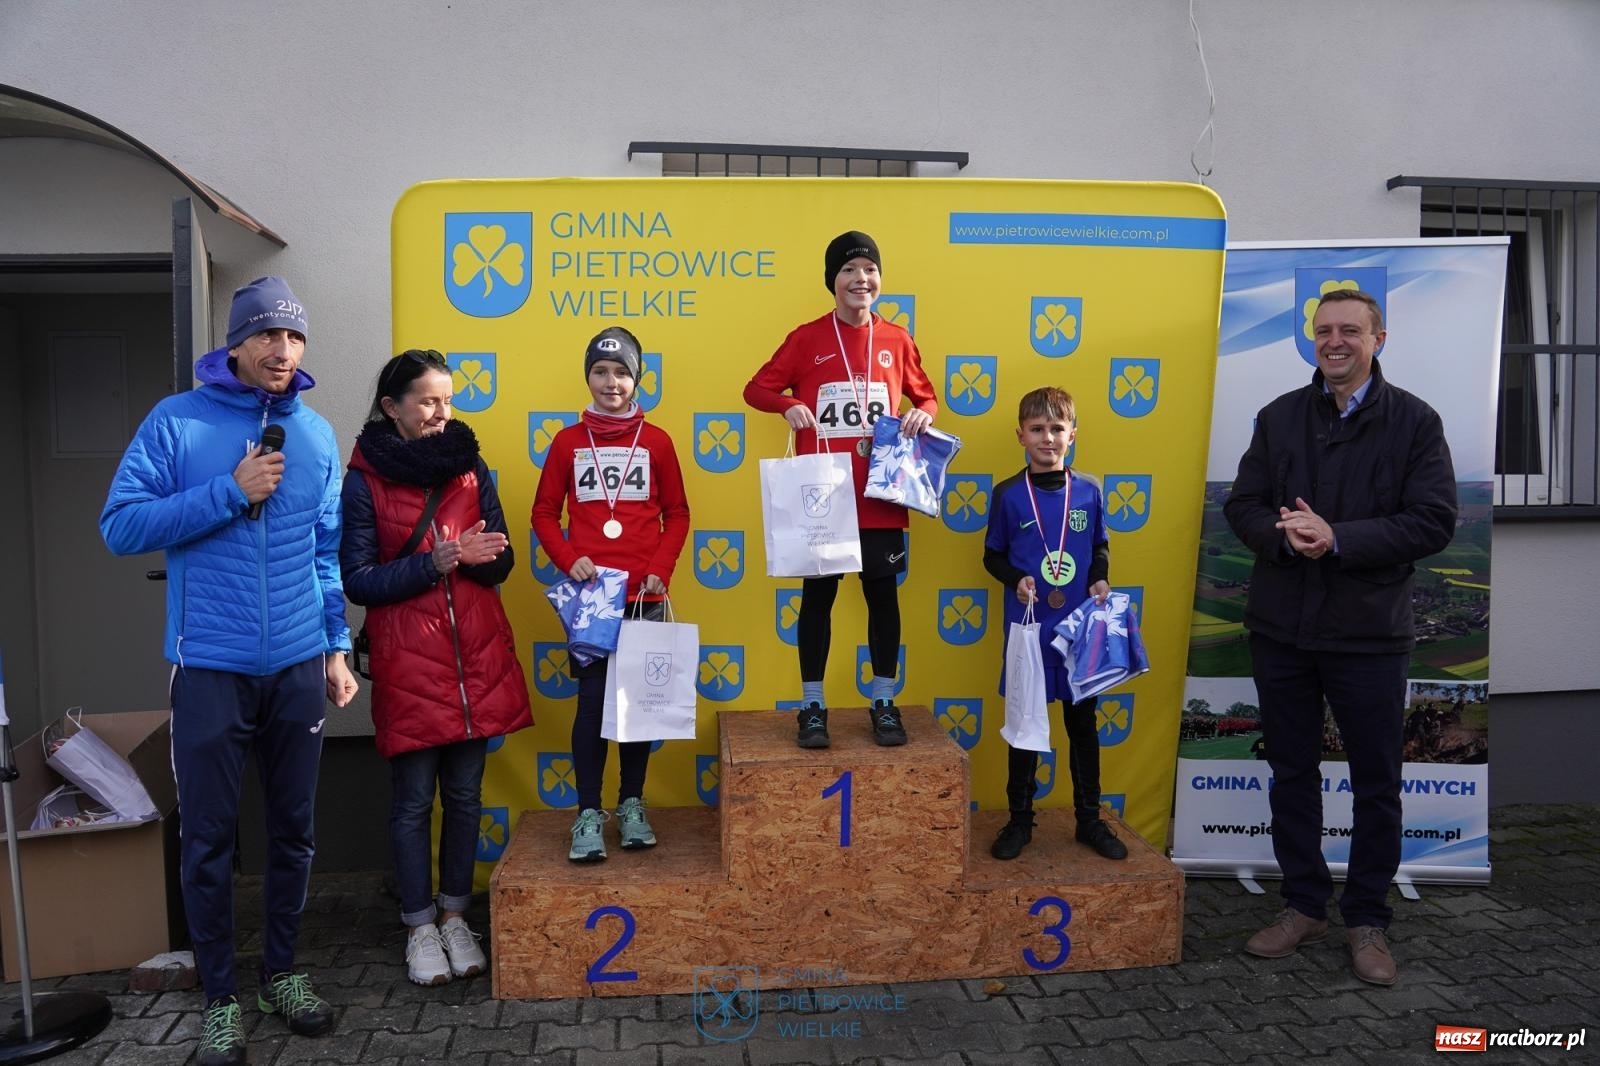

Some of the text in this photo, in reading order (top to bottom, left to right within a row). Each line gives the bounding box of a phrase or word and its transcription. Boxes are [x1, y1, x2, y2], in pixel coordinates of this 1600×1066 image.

[550, 211, 672, 239] GMINA
[955, 223, 1170, 242] www.pietrowicewielkie.com.pl
[551, 250, 776, 278] PIETROWICE
[550, 290, 697, 317] WIELKIE
[819, 401, 885, 428] 468
[578, 465, 646, 491] 464
[1191, 775, 1263, 791] GMINA
[821, 771, 853, 848] 1
[584, 905, 638, 983] 2
[1022, 896, 1072, 972] 3
